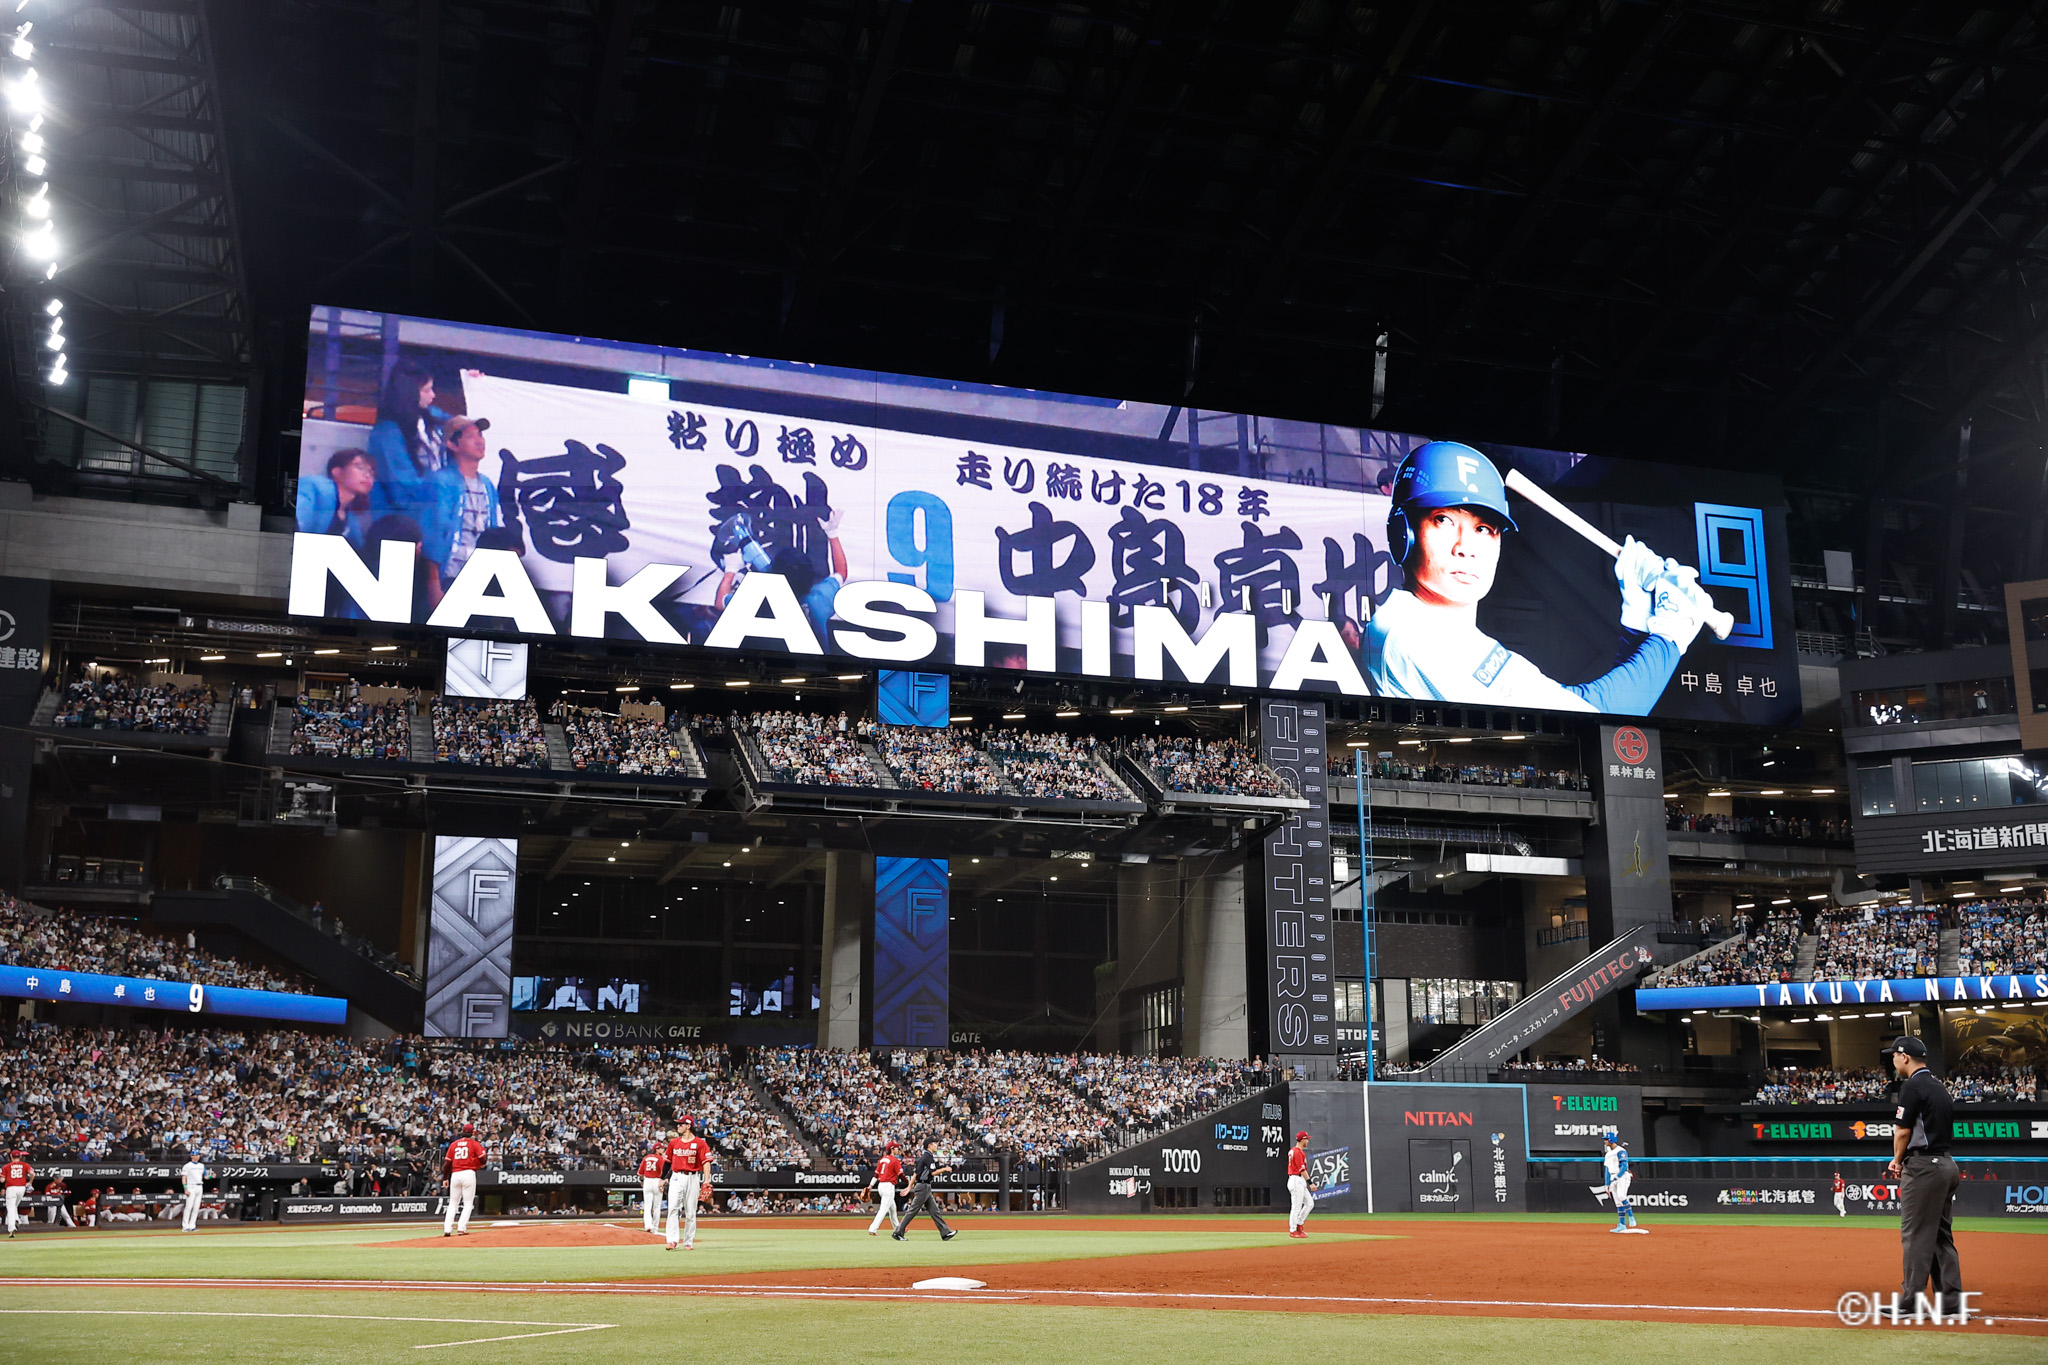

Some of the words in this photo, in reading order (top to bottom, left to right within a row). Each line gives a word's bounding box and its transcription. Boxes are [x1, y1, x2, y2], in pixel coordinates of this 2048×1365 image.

[667, 411, 868, 471] 粘り極め
[956, 449, 1271, 522] 走り続けた18年
[886, 490, 955, 602] 9
[994, 501, 1403, 649] 中島卓也
[1694, 502, 1774, 649] 9
[1160, 576, 1372, 622] TAKUYA
[288, 531, 1373, 697] NAKASHIMA
[1680, 670, 1723, 694] 中島
[1736, 674, 1778, 699] 卓也
[1609, 764, 1656, 780] 栗林商会
[1921, 823, 2048, 853] 北海道新聞
[1268, 703, 1309, 1047] FIGHTERS
[1558, 952, 1634, 1012] FUJITEC
[1755, 979, 1894, 1007] TAKUYA
[1925, 974, 2048, 1002] NAKAS
[26, 975, 71, 994] 中島
[113, 983, 156, 1002] 卓也
[188, 983, 204, 1013] 9
[1949, 1016, 1980, 1029] TOWER
[668, 1025, 702, 1039] GATE
[951, 1031, 981, 1044] GATE
[1488, 1007, 1560, 1059] エレベータ・エスカレータ
[1552, 1095, 1618, 1112] 7-ELEVEN
[1405, 1111, 1473, 1126] NITTAN
[1261, 1125, 1284, 1143] アトラス
[1554, 1124, 1589, 1136] ユンケル
[1753, 1122, 1833, 1139] 7-ELEVEN
[1953, 1121, 2020, 1138] ELEVEN
[454, 1146, 469, 1160] 20
[1161, 1148, 1201, 1173] TOTO
[222, 1166, 269, 1178] ジンワークス
[645, 1160, 657, 1172] 24
[880, 1163, 886, 1175] 1
[1109, 1167, 1133, 1176] HOKKAIDO
[1139, 1168, 1151, 1177] PARK
[1310, 1152, 1349, 1177] ASK
[498, 1171, 565, 1185] Panasonic
[795, 1171, 861, 1184] Panasonic
[950, 1172, 976, 1183] CLUB
[978, 1172, 1019, 1183] LOUGE
[1310, 1168, 1350, 1188] GATE
[1419, 1169, 1456, 1183] calmic
[1493, 1147, 1507, 1203] 北洋銀行
[1109, 1177, 1151, 1198] 北海道パーク
[1419, 1194, 1460, 1203] 日本カルミック
[1758, 1189, 1816, 1204] 北海紙管
[340, 1203, 383, 1214] kanamoto
[391, 1202, 428, 1213] LAWSON
